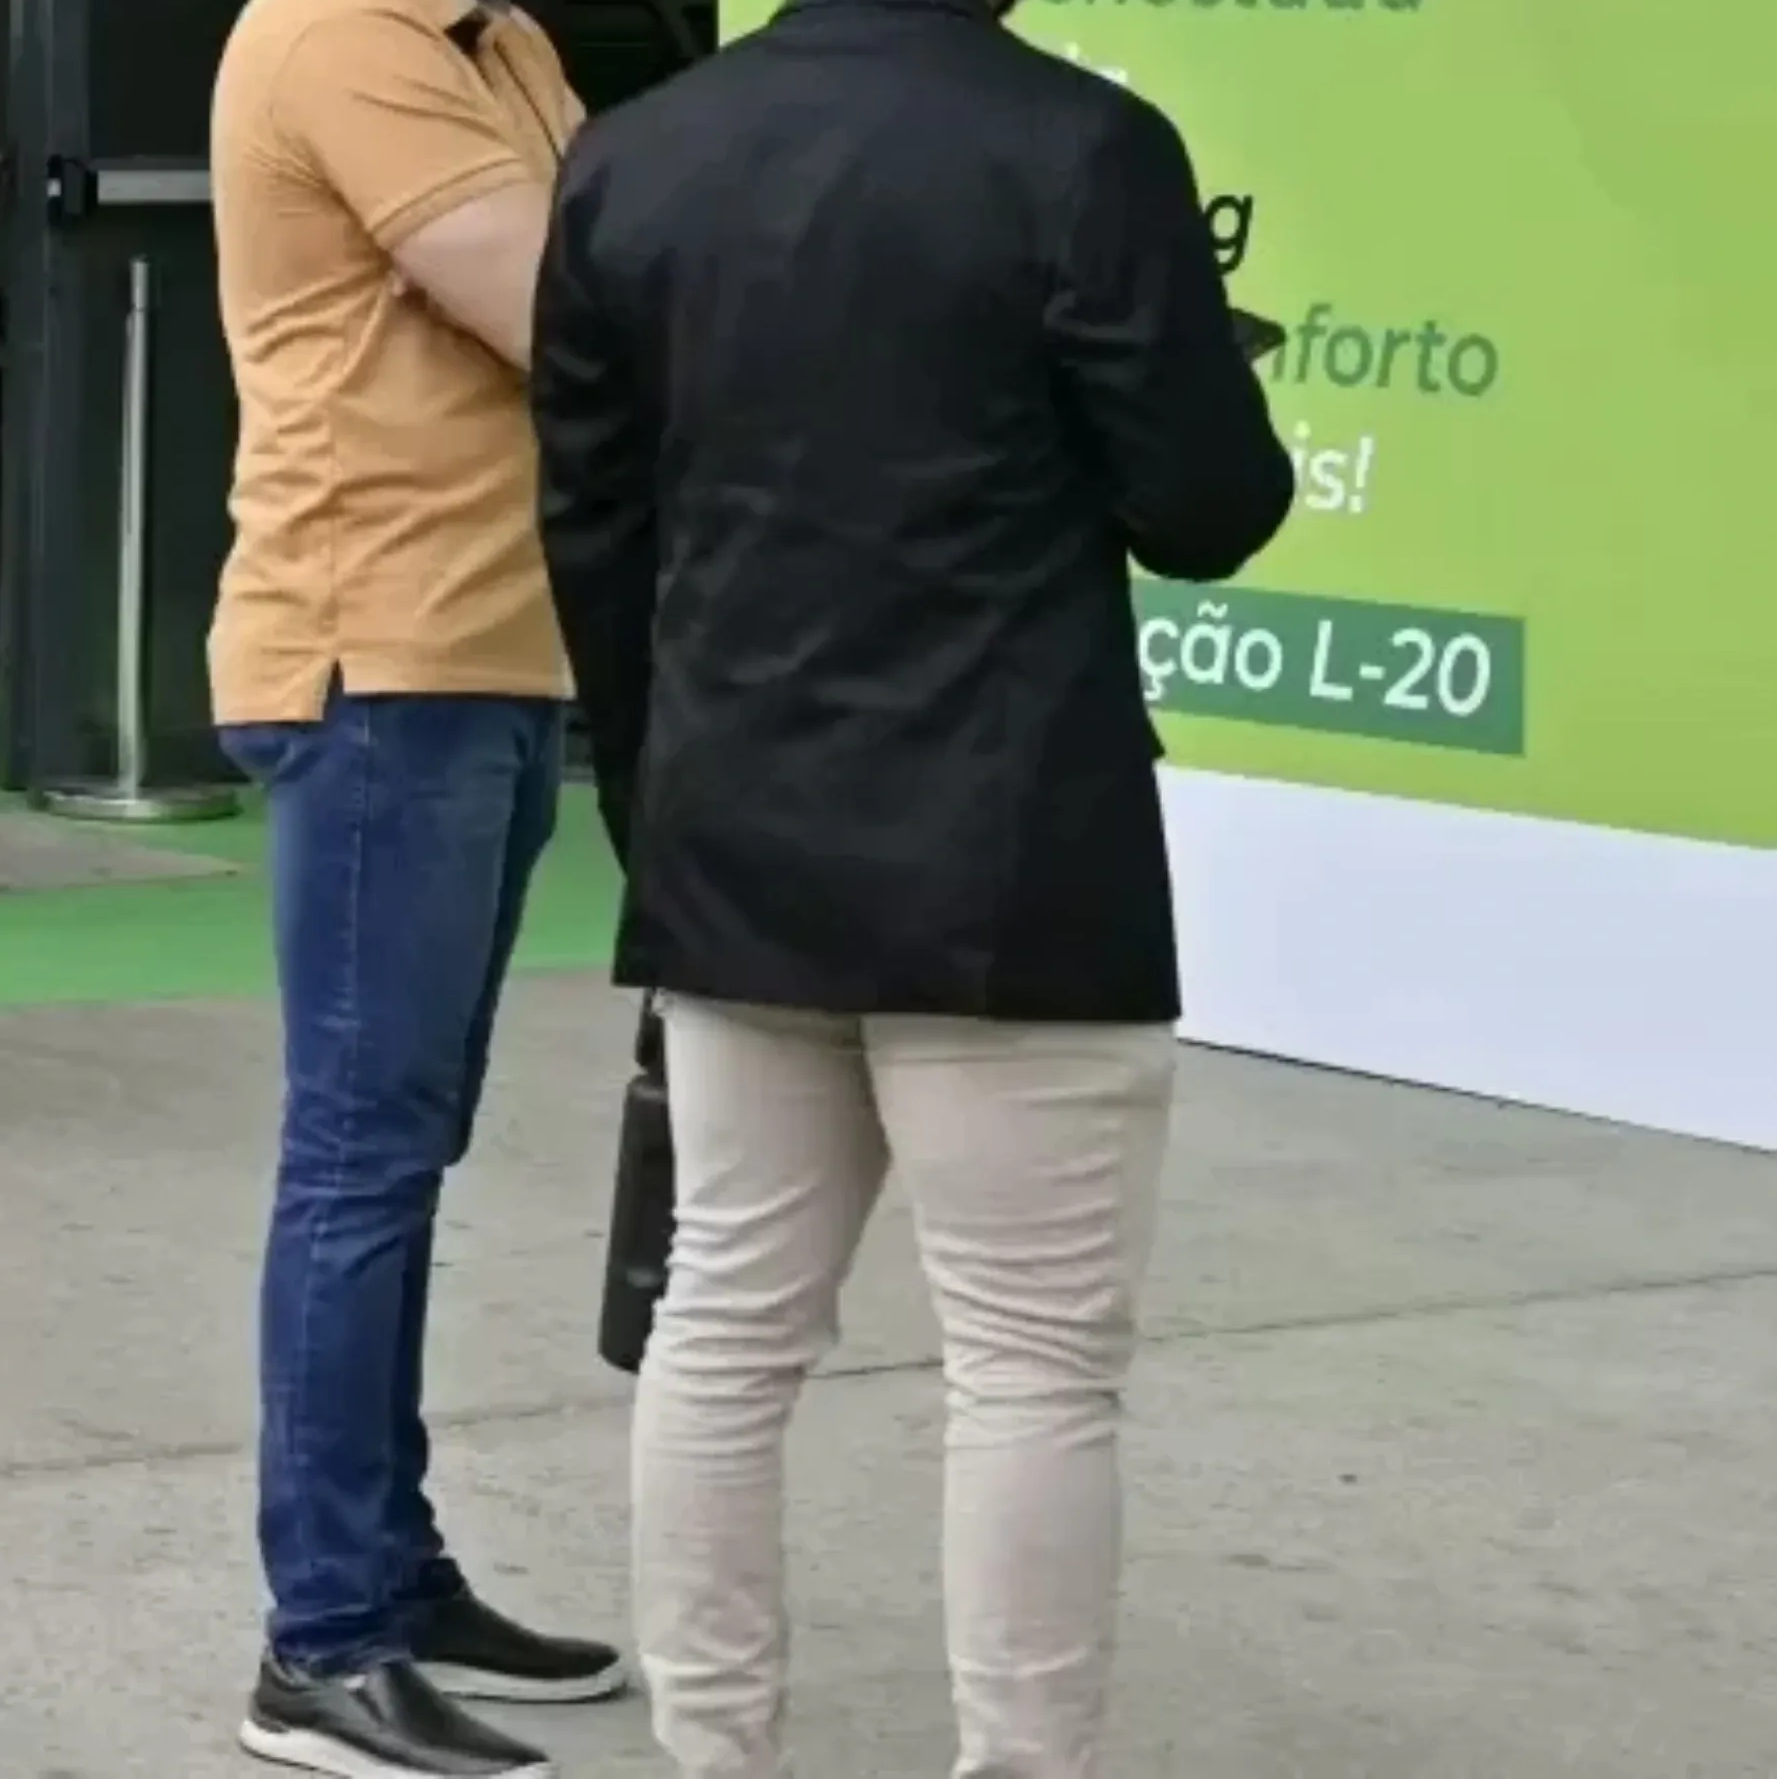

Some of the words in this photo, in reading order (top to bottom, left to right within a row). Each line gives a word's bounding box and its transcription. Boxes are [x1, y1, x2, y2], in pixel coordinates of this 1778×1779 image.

[1272, 302, 1498, 396] forto
[1293, 421, 1374, 513] is!
[1310, 619, 1491, 716] L-20
